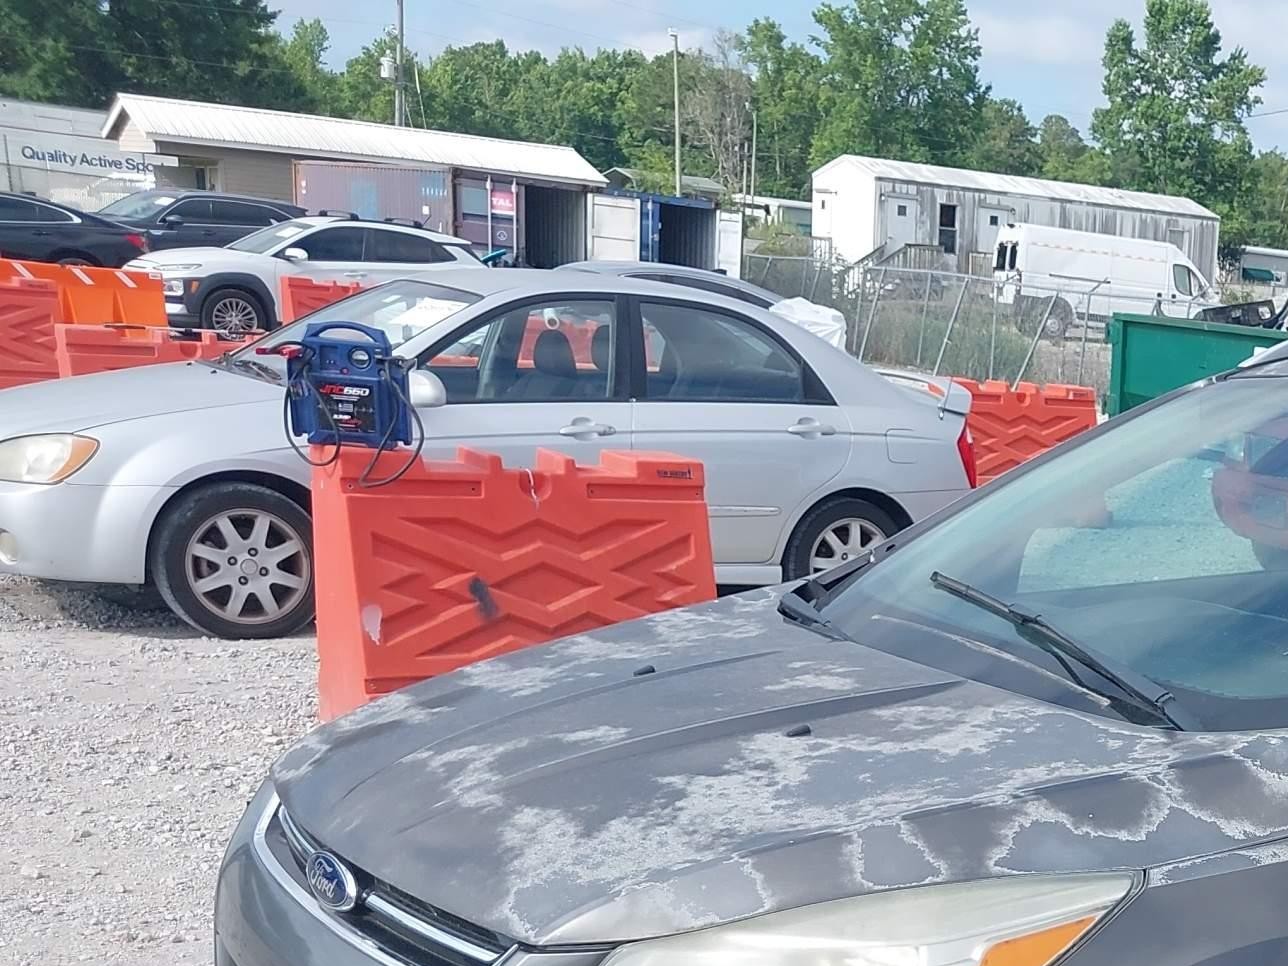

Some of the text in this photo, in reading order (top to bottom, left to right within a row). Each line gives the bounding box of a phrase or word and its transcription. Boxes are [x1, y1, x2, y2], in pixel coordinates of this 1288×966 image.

[21, 145, 77, 167] Quality
[79, 152, 122, 170] Active
[310, 858, 338, 898] Ford
